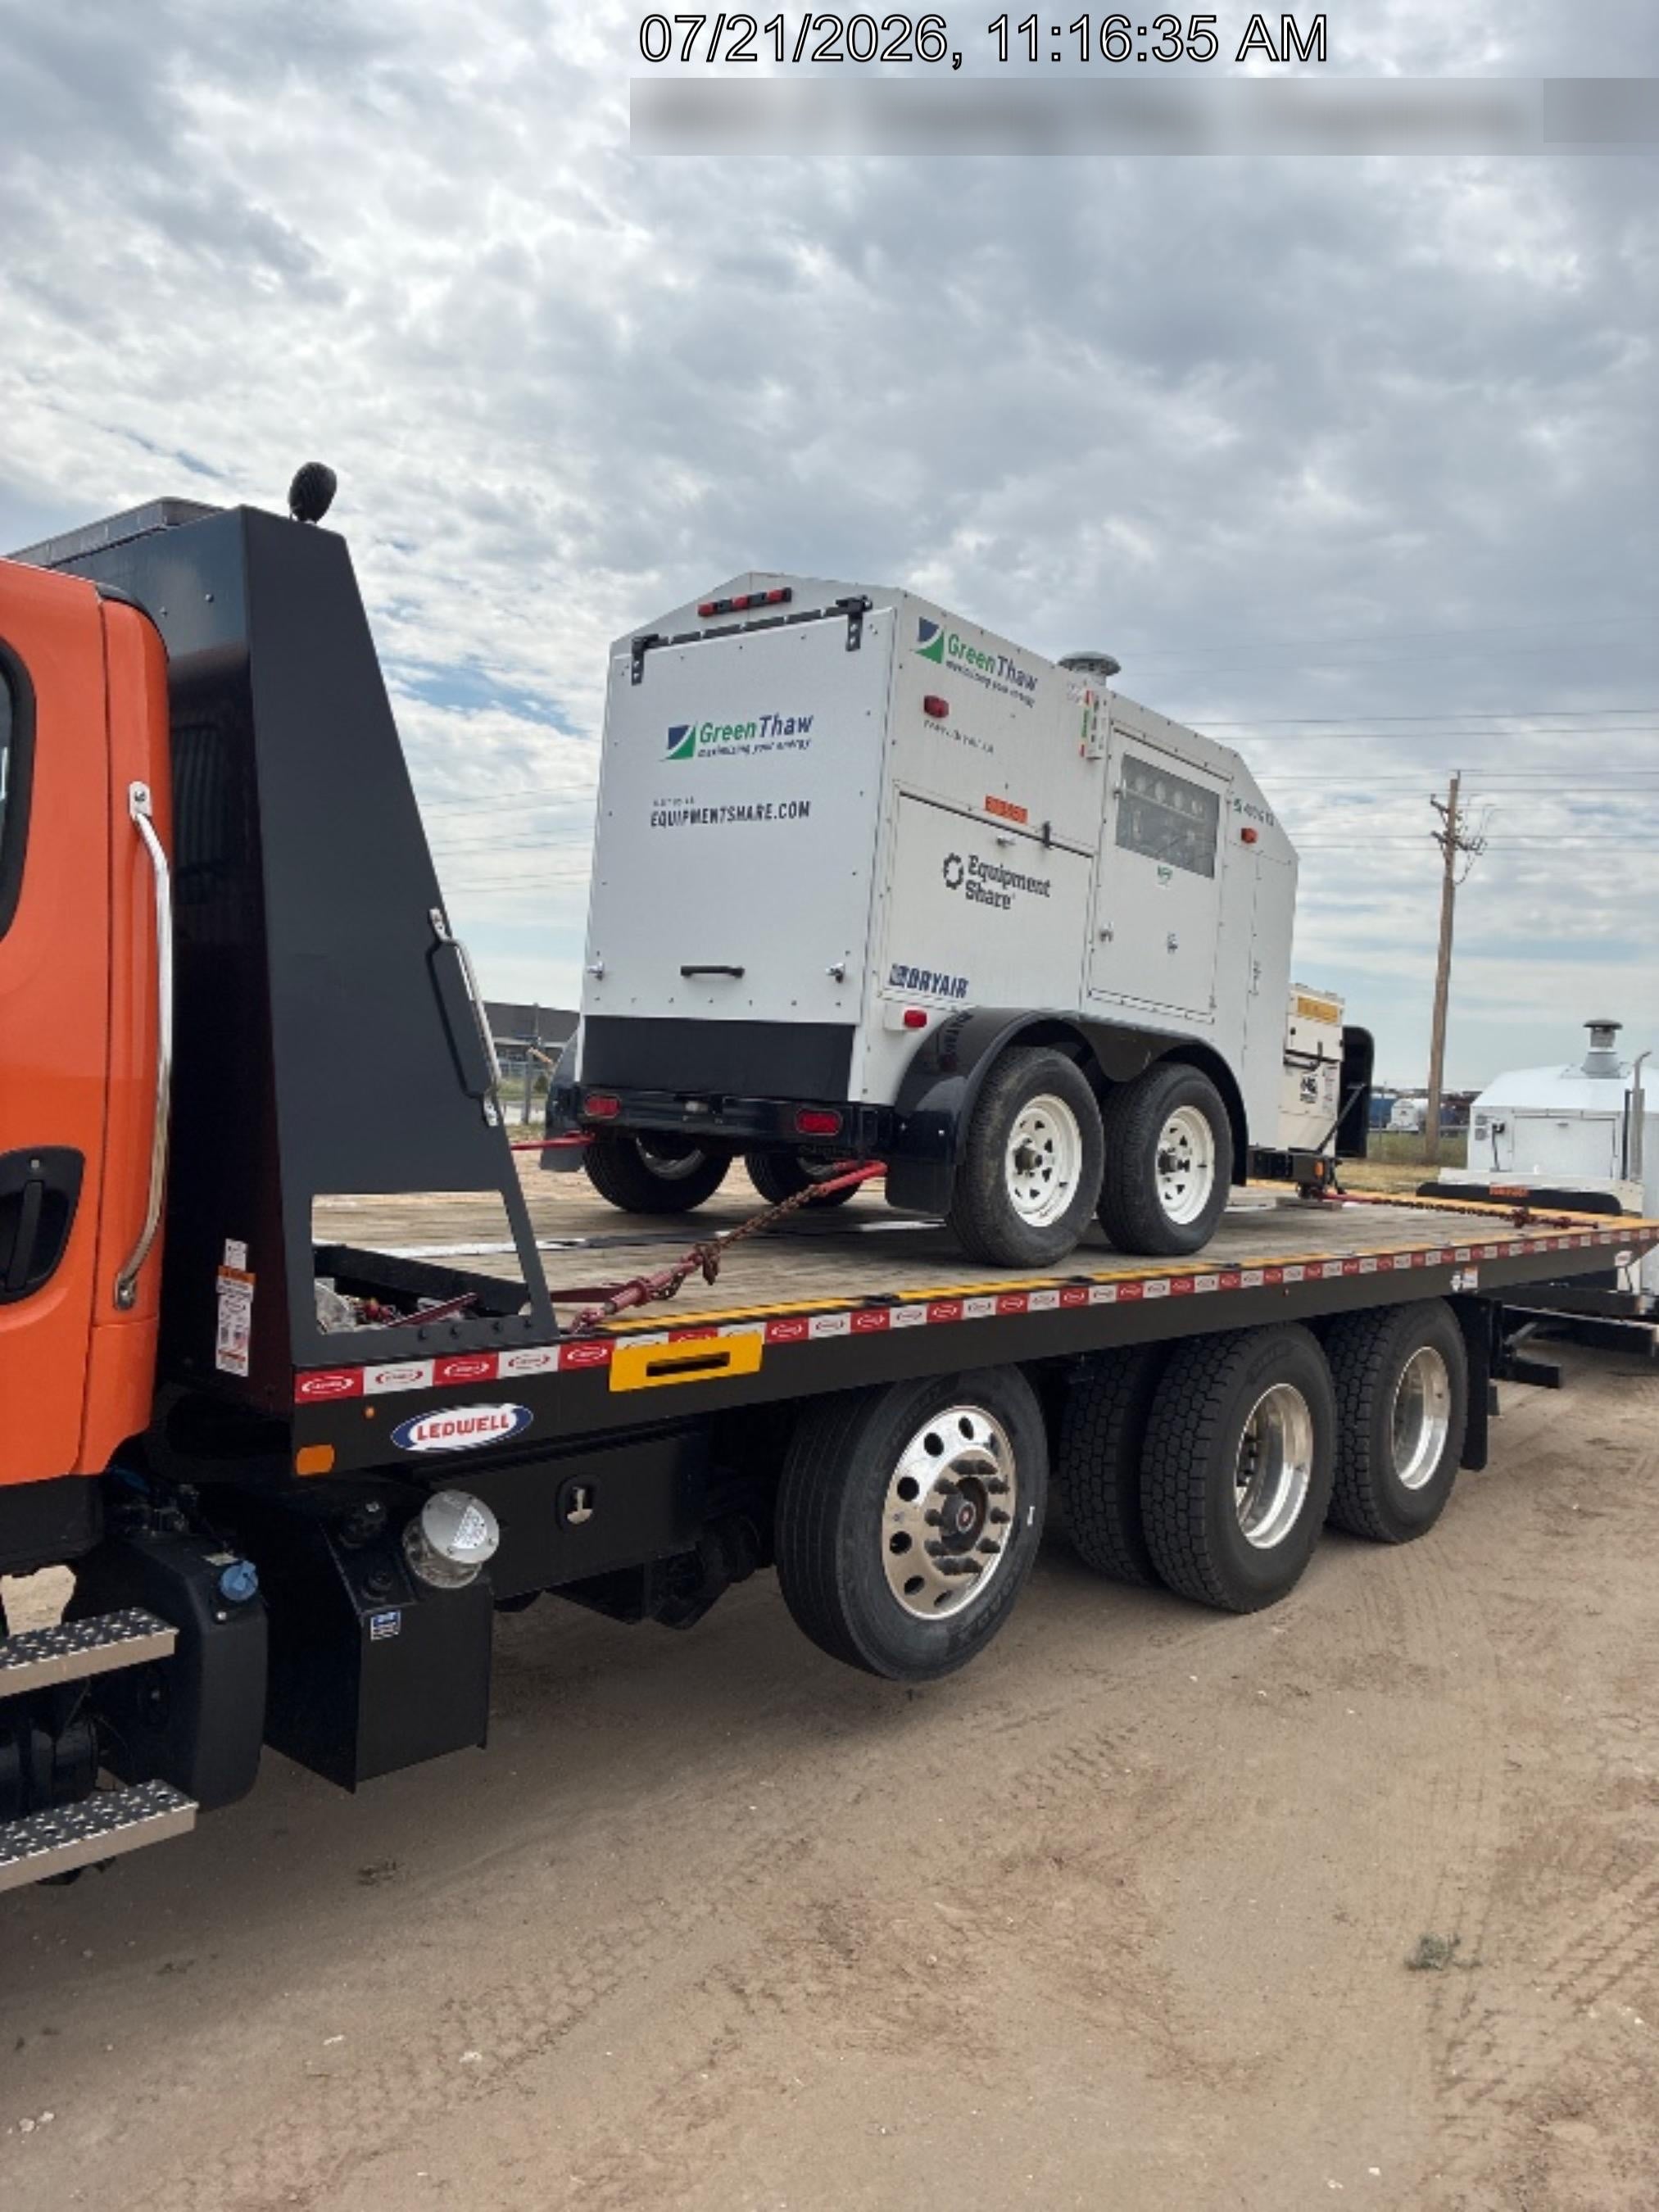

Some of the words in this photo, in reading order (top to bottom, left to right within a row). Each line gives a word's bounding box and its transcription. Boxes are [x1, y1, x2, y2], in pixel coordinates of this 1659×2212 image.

[650, 800, 811, 828] EQUIPMENTSHARE.COM
[968, 854, 1051, 898] Equipment
[965, 879, 1012, 910] Share
[416, 1413, 510, 1441] LEDWELL
